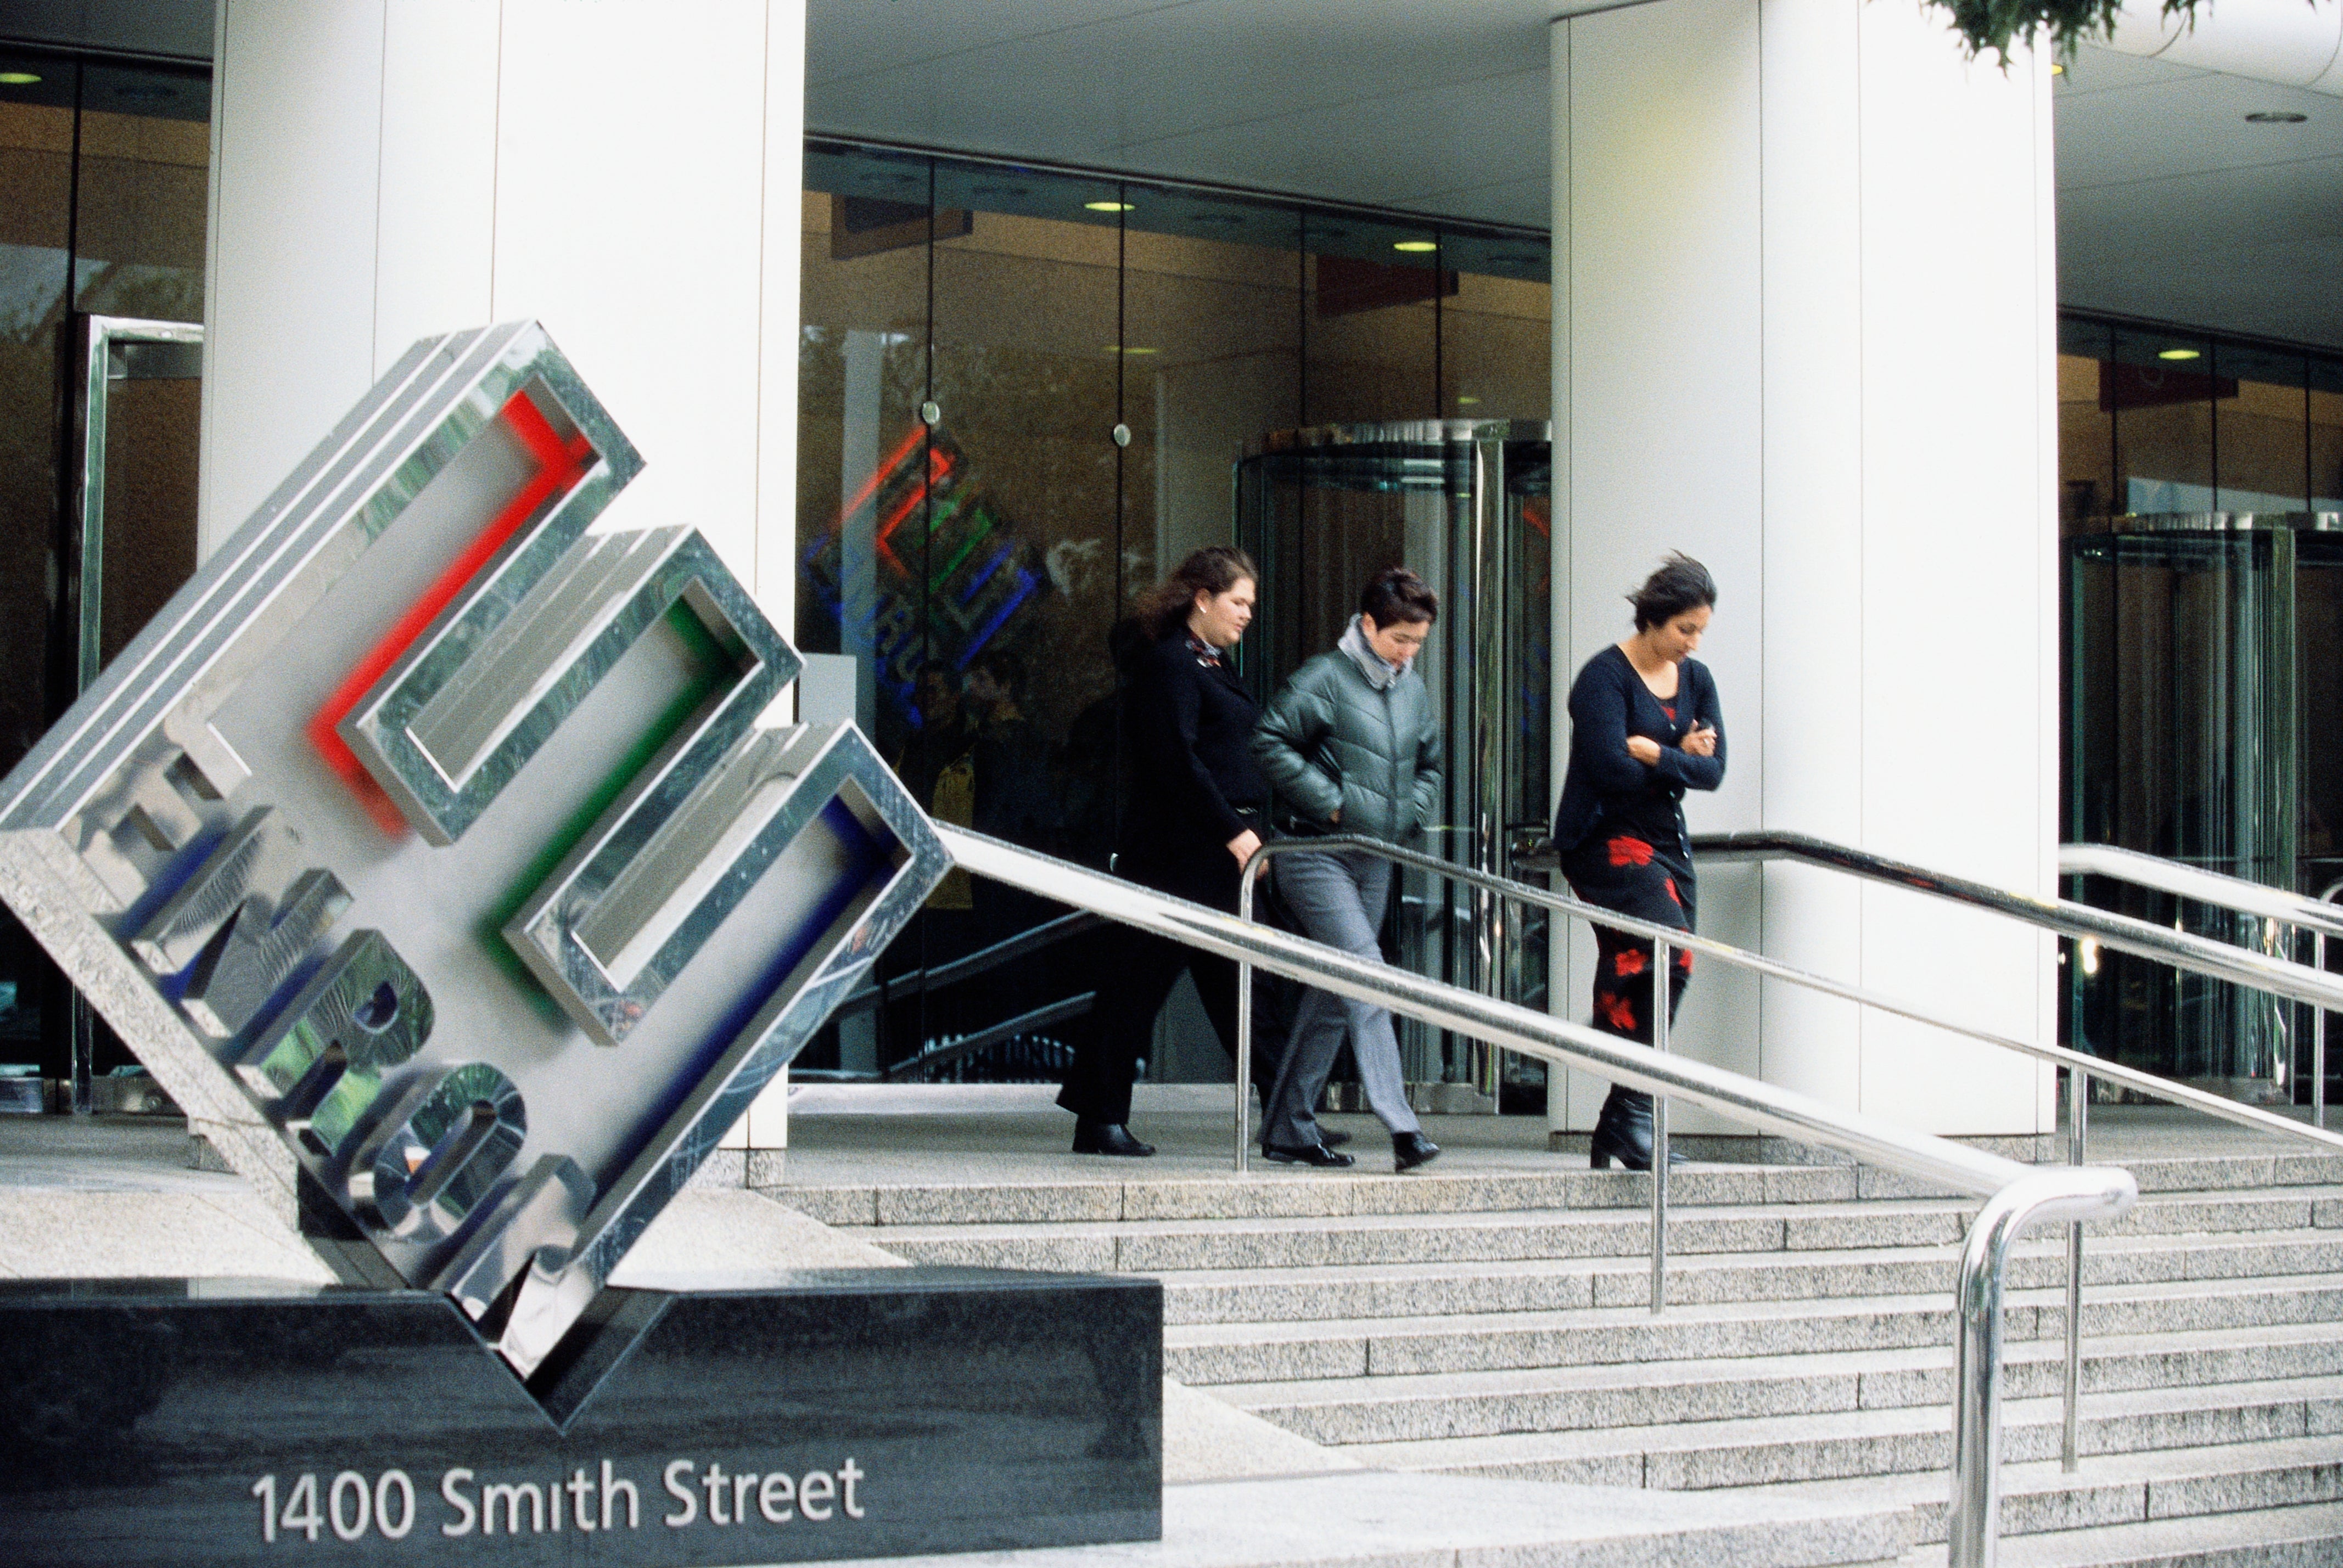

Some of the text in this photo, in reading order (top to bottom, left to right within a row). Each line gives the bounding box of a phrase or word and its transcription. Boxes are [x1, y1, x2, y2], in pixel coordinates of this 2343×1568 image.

[59, 708, 598, 1382] ENRON
[252, 1457, 866, 1542] 1400 Smith Street
